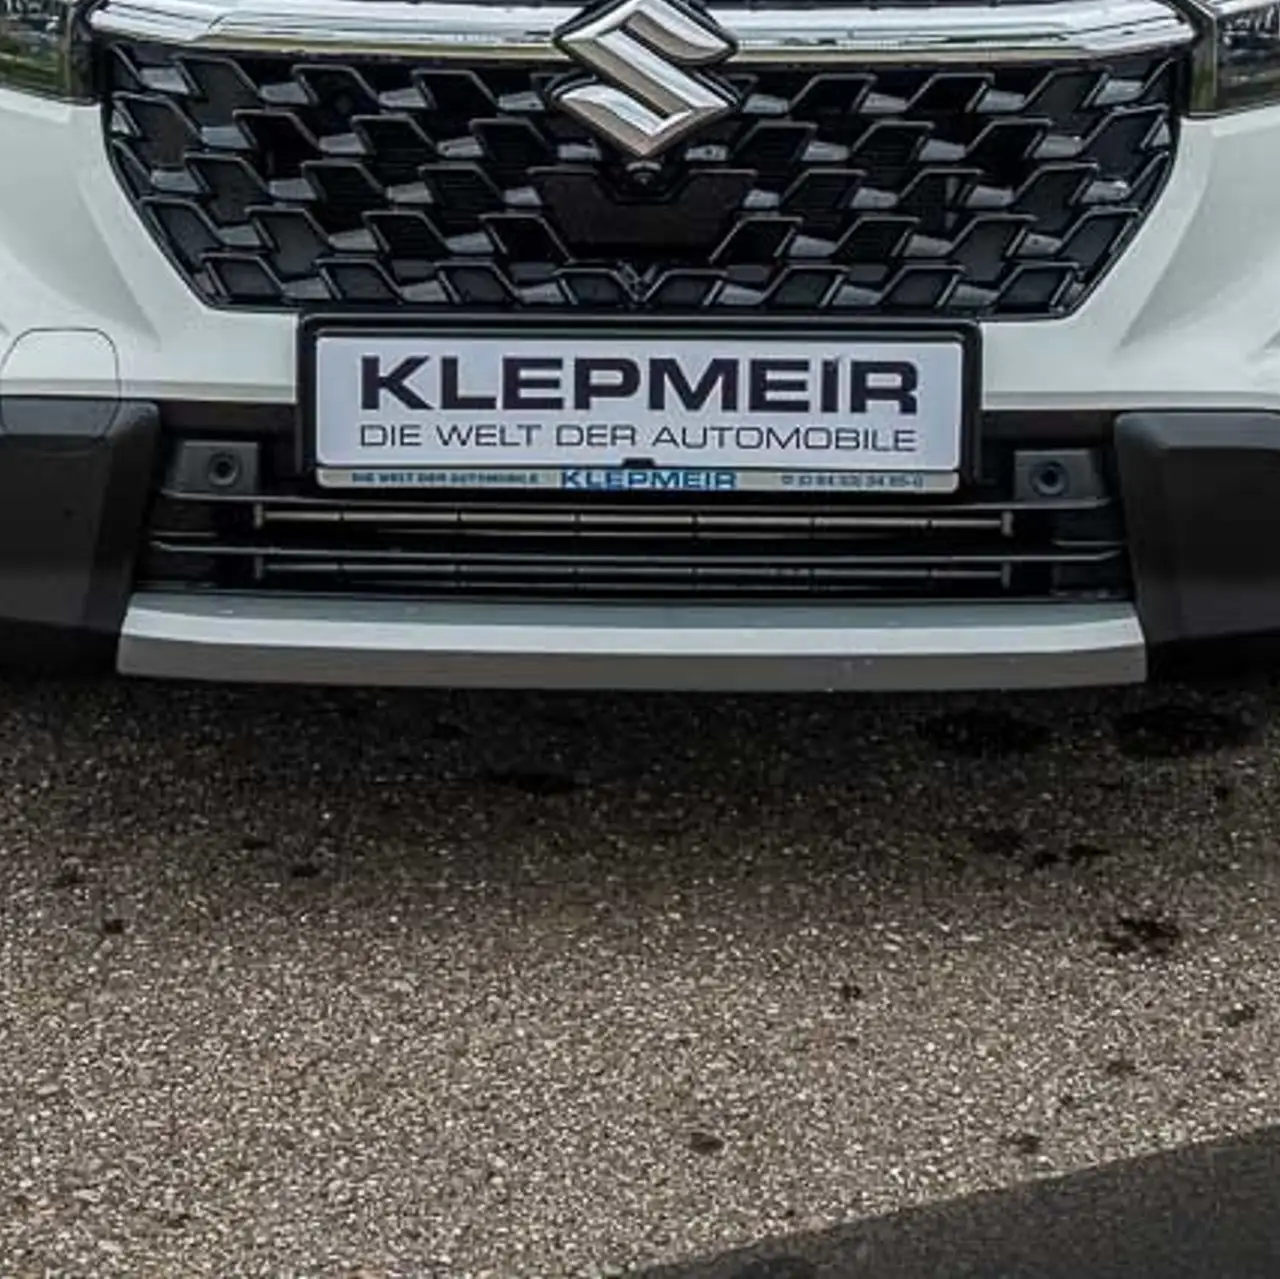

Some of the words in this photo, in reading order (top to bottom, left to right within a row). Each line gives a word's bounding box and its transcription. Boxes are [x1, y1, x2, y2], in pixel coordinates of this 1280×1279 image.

[360, 356, 918, 415] KLEPMEIR
[360, 424, 422, 448] DIE
[436, 424, 542, 448] WELT
[556, 424, 637, 449] DER
[652, 426, 917, 453] AUTOMOBILE
[561, 469, 738, 490] KLEPMEIR
